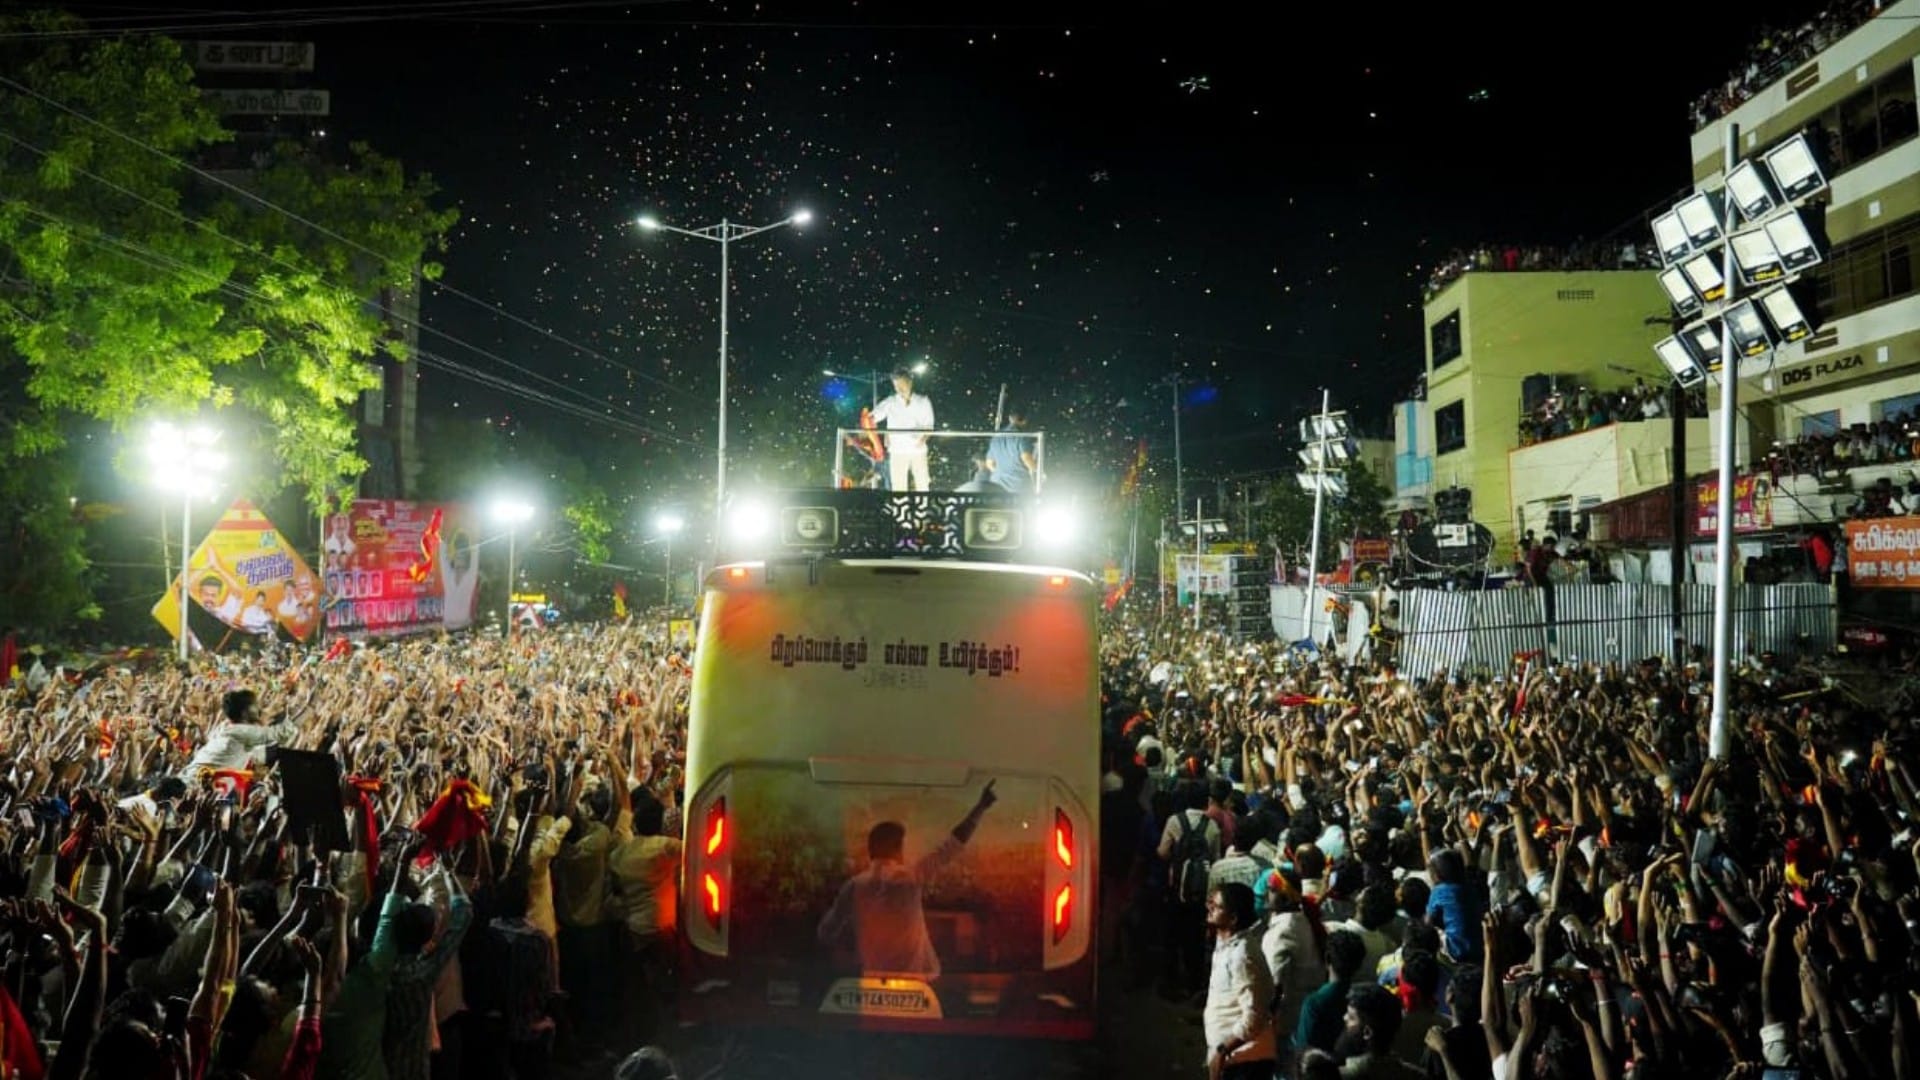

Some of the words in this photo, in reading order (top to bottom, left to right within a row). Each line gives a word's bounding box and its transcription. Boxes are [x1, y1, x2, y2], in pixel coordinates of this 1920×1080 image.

[1782, 365, 1812, 386] DDS
[1816, 354, 1864, 377] PLAZA
[771, 633, 868, 670] பிறப்பொக்கும்
[884, 638, 929, 667] எல்லா
